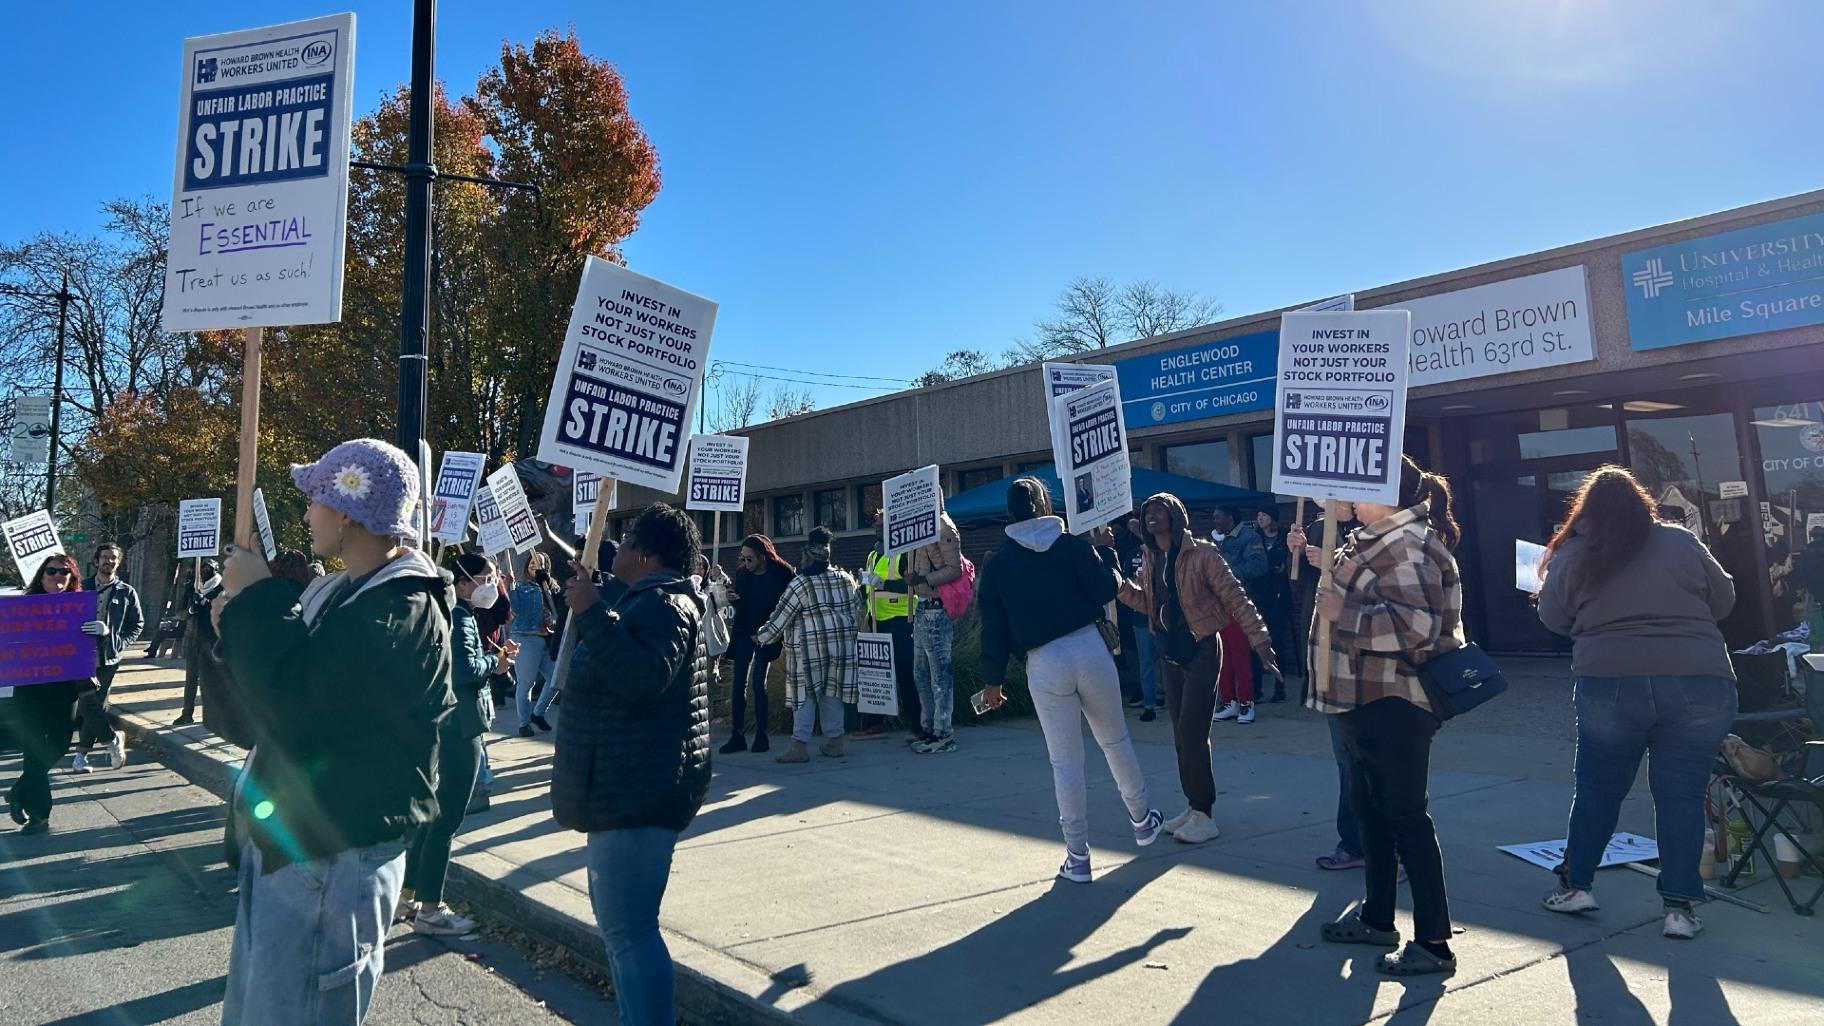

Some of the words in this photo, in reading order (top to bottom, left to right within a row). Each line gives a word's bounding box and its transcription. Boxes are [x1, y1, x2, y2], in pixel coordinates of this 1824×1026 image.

[221, 55, 249, 66] HOWARD
[250, 52, 274, 62] BROWN
[275, 48, 300, 58] HEALTH
[307, 45, 327, 58] INA
[221, 64, 264, 78] WORKERS
[266, 58, 298, 72] UNITED
[197, 96, 234, 117] UNFAIR
[238, 90, 272, 111] LABOR
[276, 82, 327, 106] PRACTICE
[193, 108, 325, 180] STRIKE
[181, 196, 206, 219] If
[214, 204, 236, 217] we
[247, 198, 276, 212] are
[200, 216, 312, 255] ESSENTIAL
[1680, 233, 1824, 272] UNIVERSITY
[176, 268, 224, 293] Treat
[231, 274, 248, 286] us
[256, 272, 270, 282] as
[1682, 268, 1750, 290] Hospital
[1757, 263, 1771, 277] &
[1778, 254, 1824, 273] Healt
[621, 290, 666, 312] INVEST
[668, 306, 681, 319] IN
[1686, 306, 1732, 327] Mile
[1740, 293, 1822, 320] Square
[598, 296, 632, 318] YOUR
[636, 310, 697, 340] WORKERS
[1413, 310, 1487, 347] oward
[1495, 300, 1577, 332] Brown
[595, 312, 622, 330] NOT
[624, 322, 656, 340] JUST
[658, 333, 692, 354] YOUR
[1312, 329, 1354, 340] INVEST
[1356, 329, 1370, 339] IN
[582, 325, 626, 348] STOCK
[628, 340, 696, 370] PORTFOLIO
[1160, 345, 1240, 372] ENGLEWOOD
[1292, 344, 1324, 354] YOUR
[1328, 344, 1390, 353] WORKERS
[1484, 332, 1534, 364] 63rd
[1542, 331, 1572, 353] St.
[600, 358, 622, 370] HOWARD
[624, 364, 642, 376] BROWN
[643, 370, 662, 380] HEALTH
[1152, 370, 1196, 390] HEALTH
[1200, 360, 1252, 381] CENTER
[1294, 358, 1318, 368] NOT
[1320, 358, 1350, 368] JUST
[1352, 358, 1387, 368] YOUR
[598, 365, 634, 382] WORKERS
[634, 376, 660, 390] UNITED
[667, 382, 682, 392] INA
[1284, 371, 1322, 381] STOCK
[1325, 372, 1395, 382] PORTFOLIO
[574, 380, 607, 398] UNFAIR
[608, 390, 638, 407] LABOR
[638, 398, 680, 421] PRACTICE
[1170, 402, 1192, 414] CITY
[1195, 398, 1208, 410] OF
[1212, 391, 1258, 408] CHICAGO
[1304, 402, 1336, 410] WORKERS
[1338, 402, 1363, 410] UNITED
[1369, 398, 1384, 406] INA
[1774, 403, 1809, 421] 641
[565, 398, 676, 463] STRIKE
[1287, 419, 1315, 430] UNFAIR
[1318, 420, 1342, 432] LABOR
[1345, 422, 1384, 434] PRACTICE
[1073, 422, 1119, 464] STRIKE
[1286, 434, 1383, 476] STRIKE
[1762, 458, 1790, 472] CITY
[1793, 457, 1810, 470] OF
[440, 478, 472, 496] STRIKE
[578, 481, 596, 502] STRI
[693, 484, 738, 502] STRIKE
[480, 504, 500, 522] STR
[510, 518, 535, 542] STRIKE
[891, 520, 934, 546] STRIKE
[14, 530, 54, 556] STRIKE
[182, 536, 214, 549] STRIKE
[858, 642, 890, 660] STRIKE
